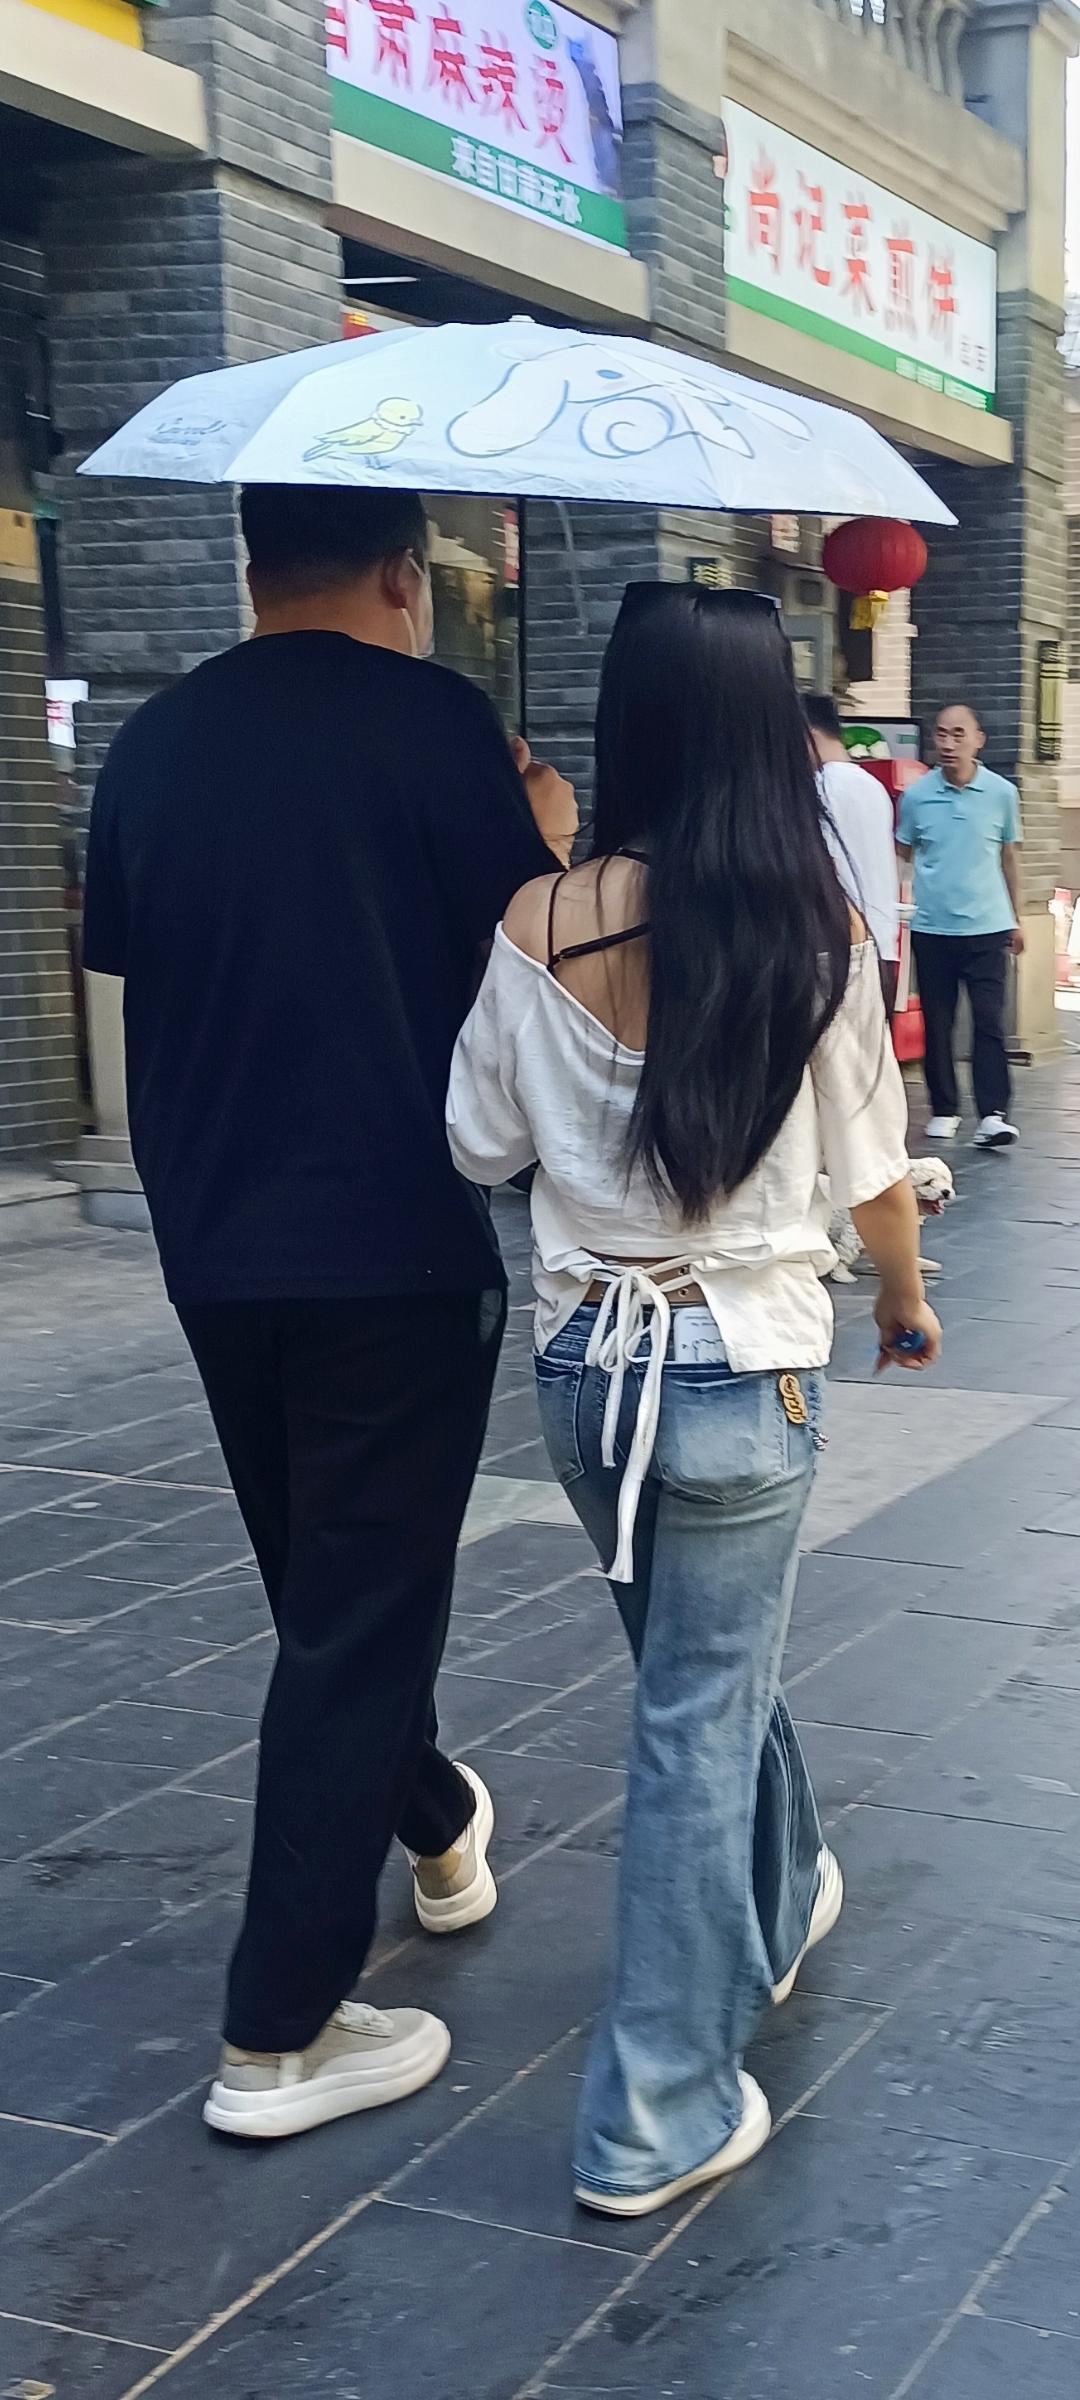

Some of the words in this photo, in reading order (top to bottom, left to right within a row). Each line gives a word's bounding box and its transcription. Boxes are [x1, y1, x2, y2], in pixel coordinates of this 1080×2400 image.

[450, 134, 583, 225] 来自甘肃天水
[746, 142, 958, 358] 尚记菜煎饼
